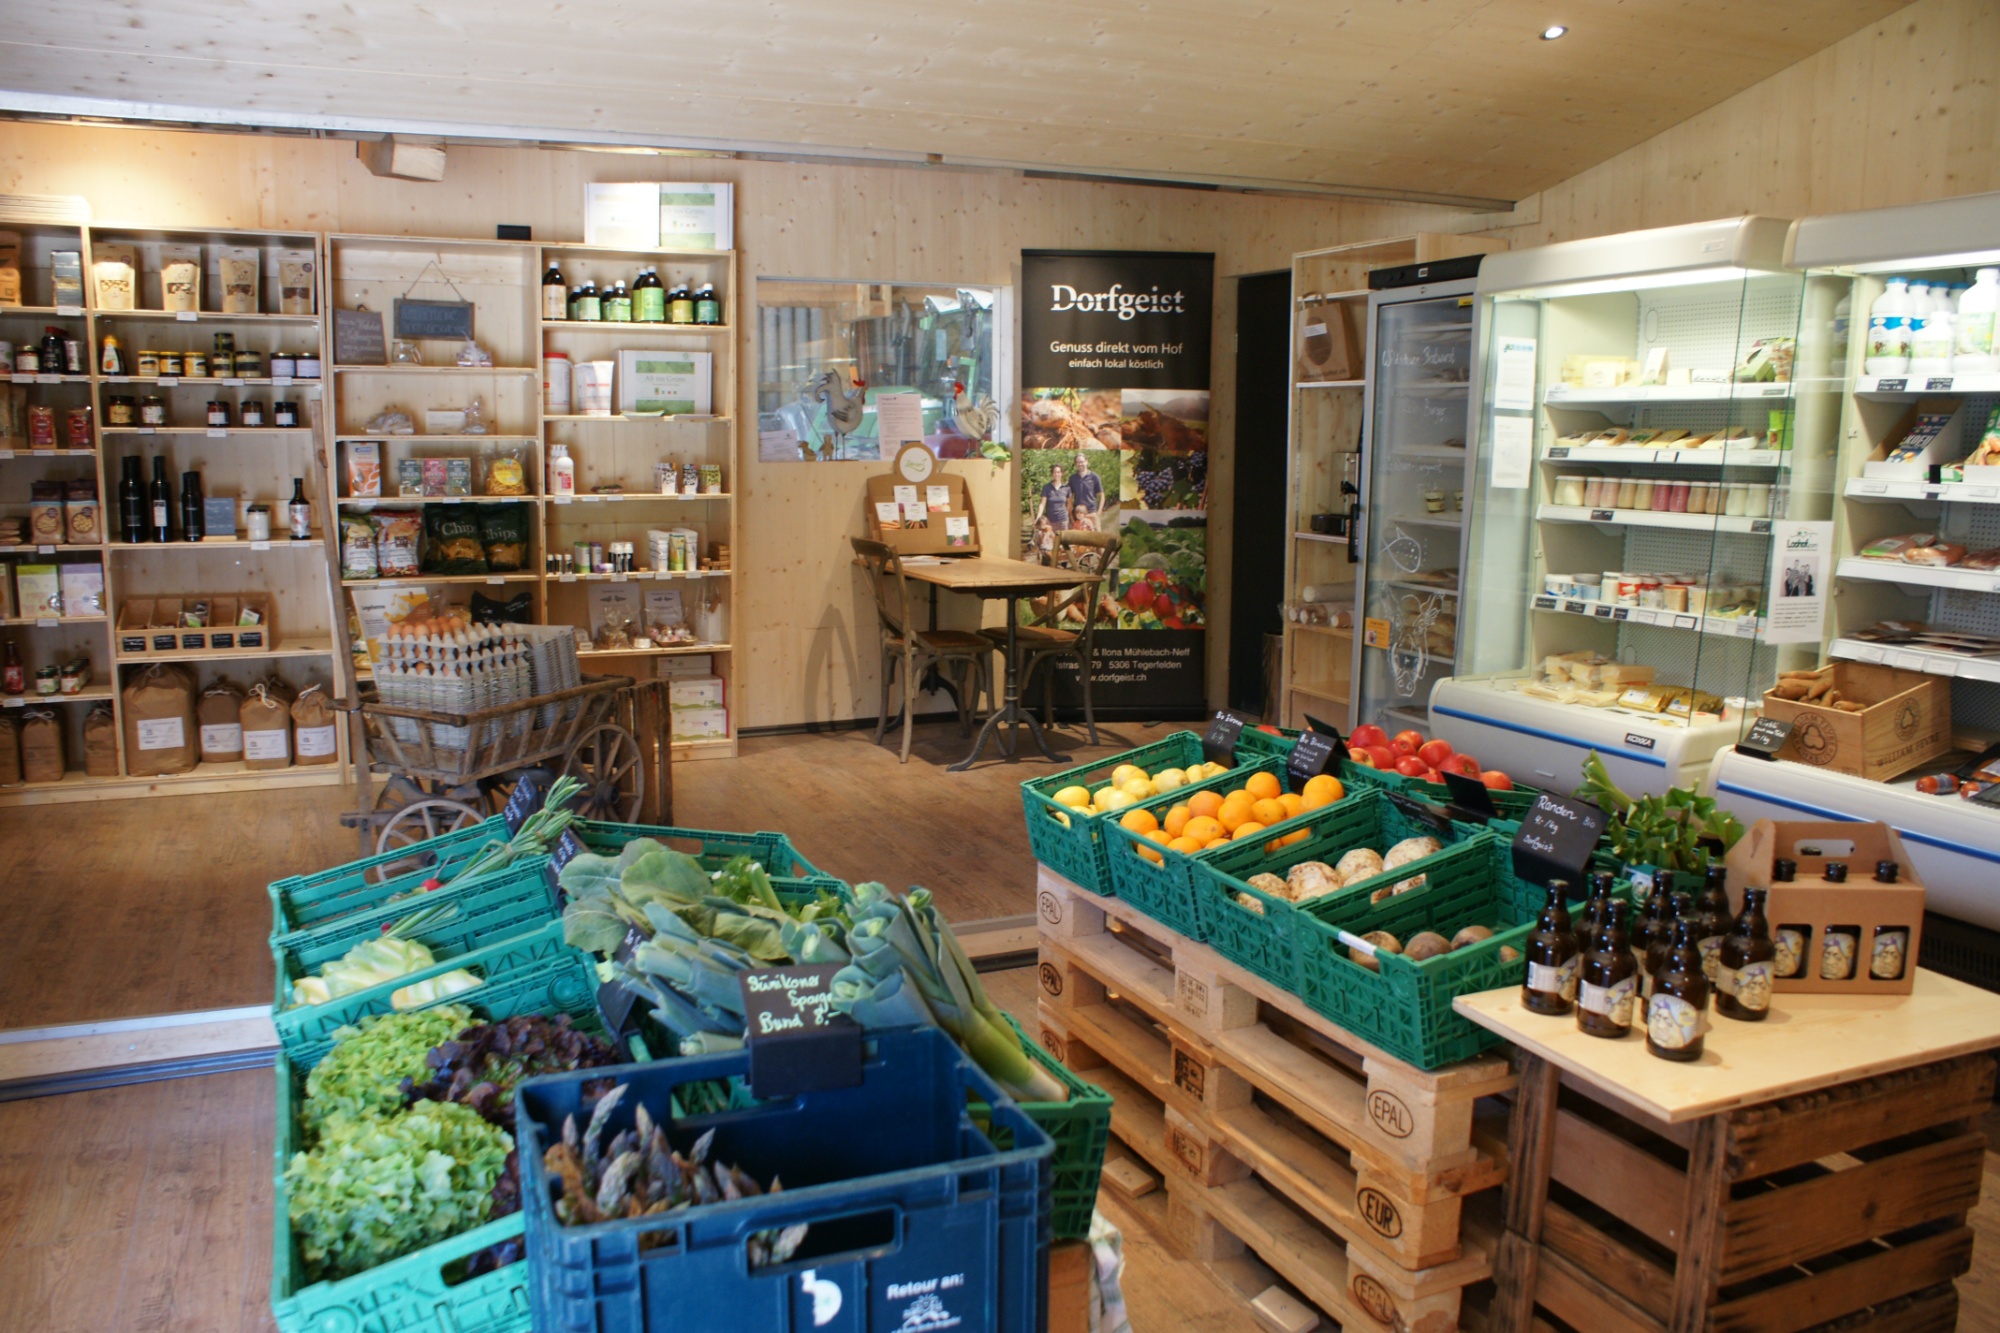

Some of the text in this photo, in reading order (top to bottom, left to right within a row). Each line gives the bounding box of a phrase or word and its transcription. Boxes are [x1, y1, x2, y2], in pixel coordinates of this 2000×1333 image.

[1050, 283, 1186, 321] Dorfgeist
[1050, 341, 1184, 355] Genuss direkt vom Hof
[1068, 358, 1165, 370] einfach lokal köstlich
[1092, 647, 1191, 657] & Ilona Mühlebach-Neff
[1108, 661, 1130, 670] 5306
[1133, 661, 1182, 671] Tegerfelden
[1537, 795, 1596, 829] Randen Bio
[1041, 895, 1059, 921] EPAL
[1042, 966, 1059, 992] EPAL
[758, 1010, 804, 1034] Bund
[1373, 1096, 1407, 1134] EPAL
[1365, 1193, 1393, 1234] EUR
[886, 1278, 939, 1301] Retour
[1360, 1280, 1391, 1319] EPAL
